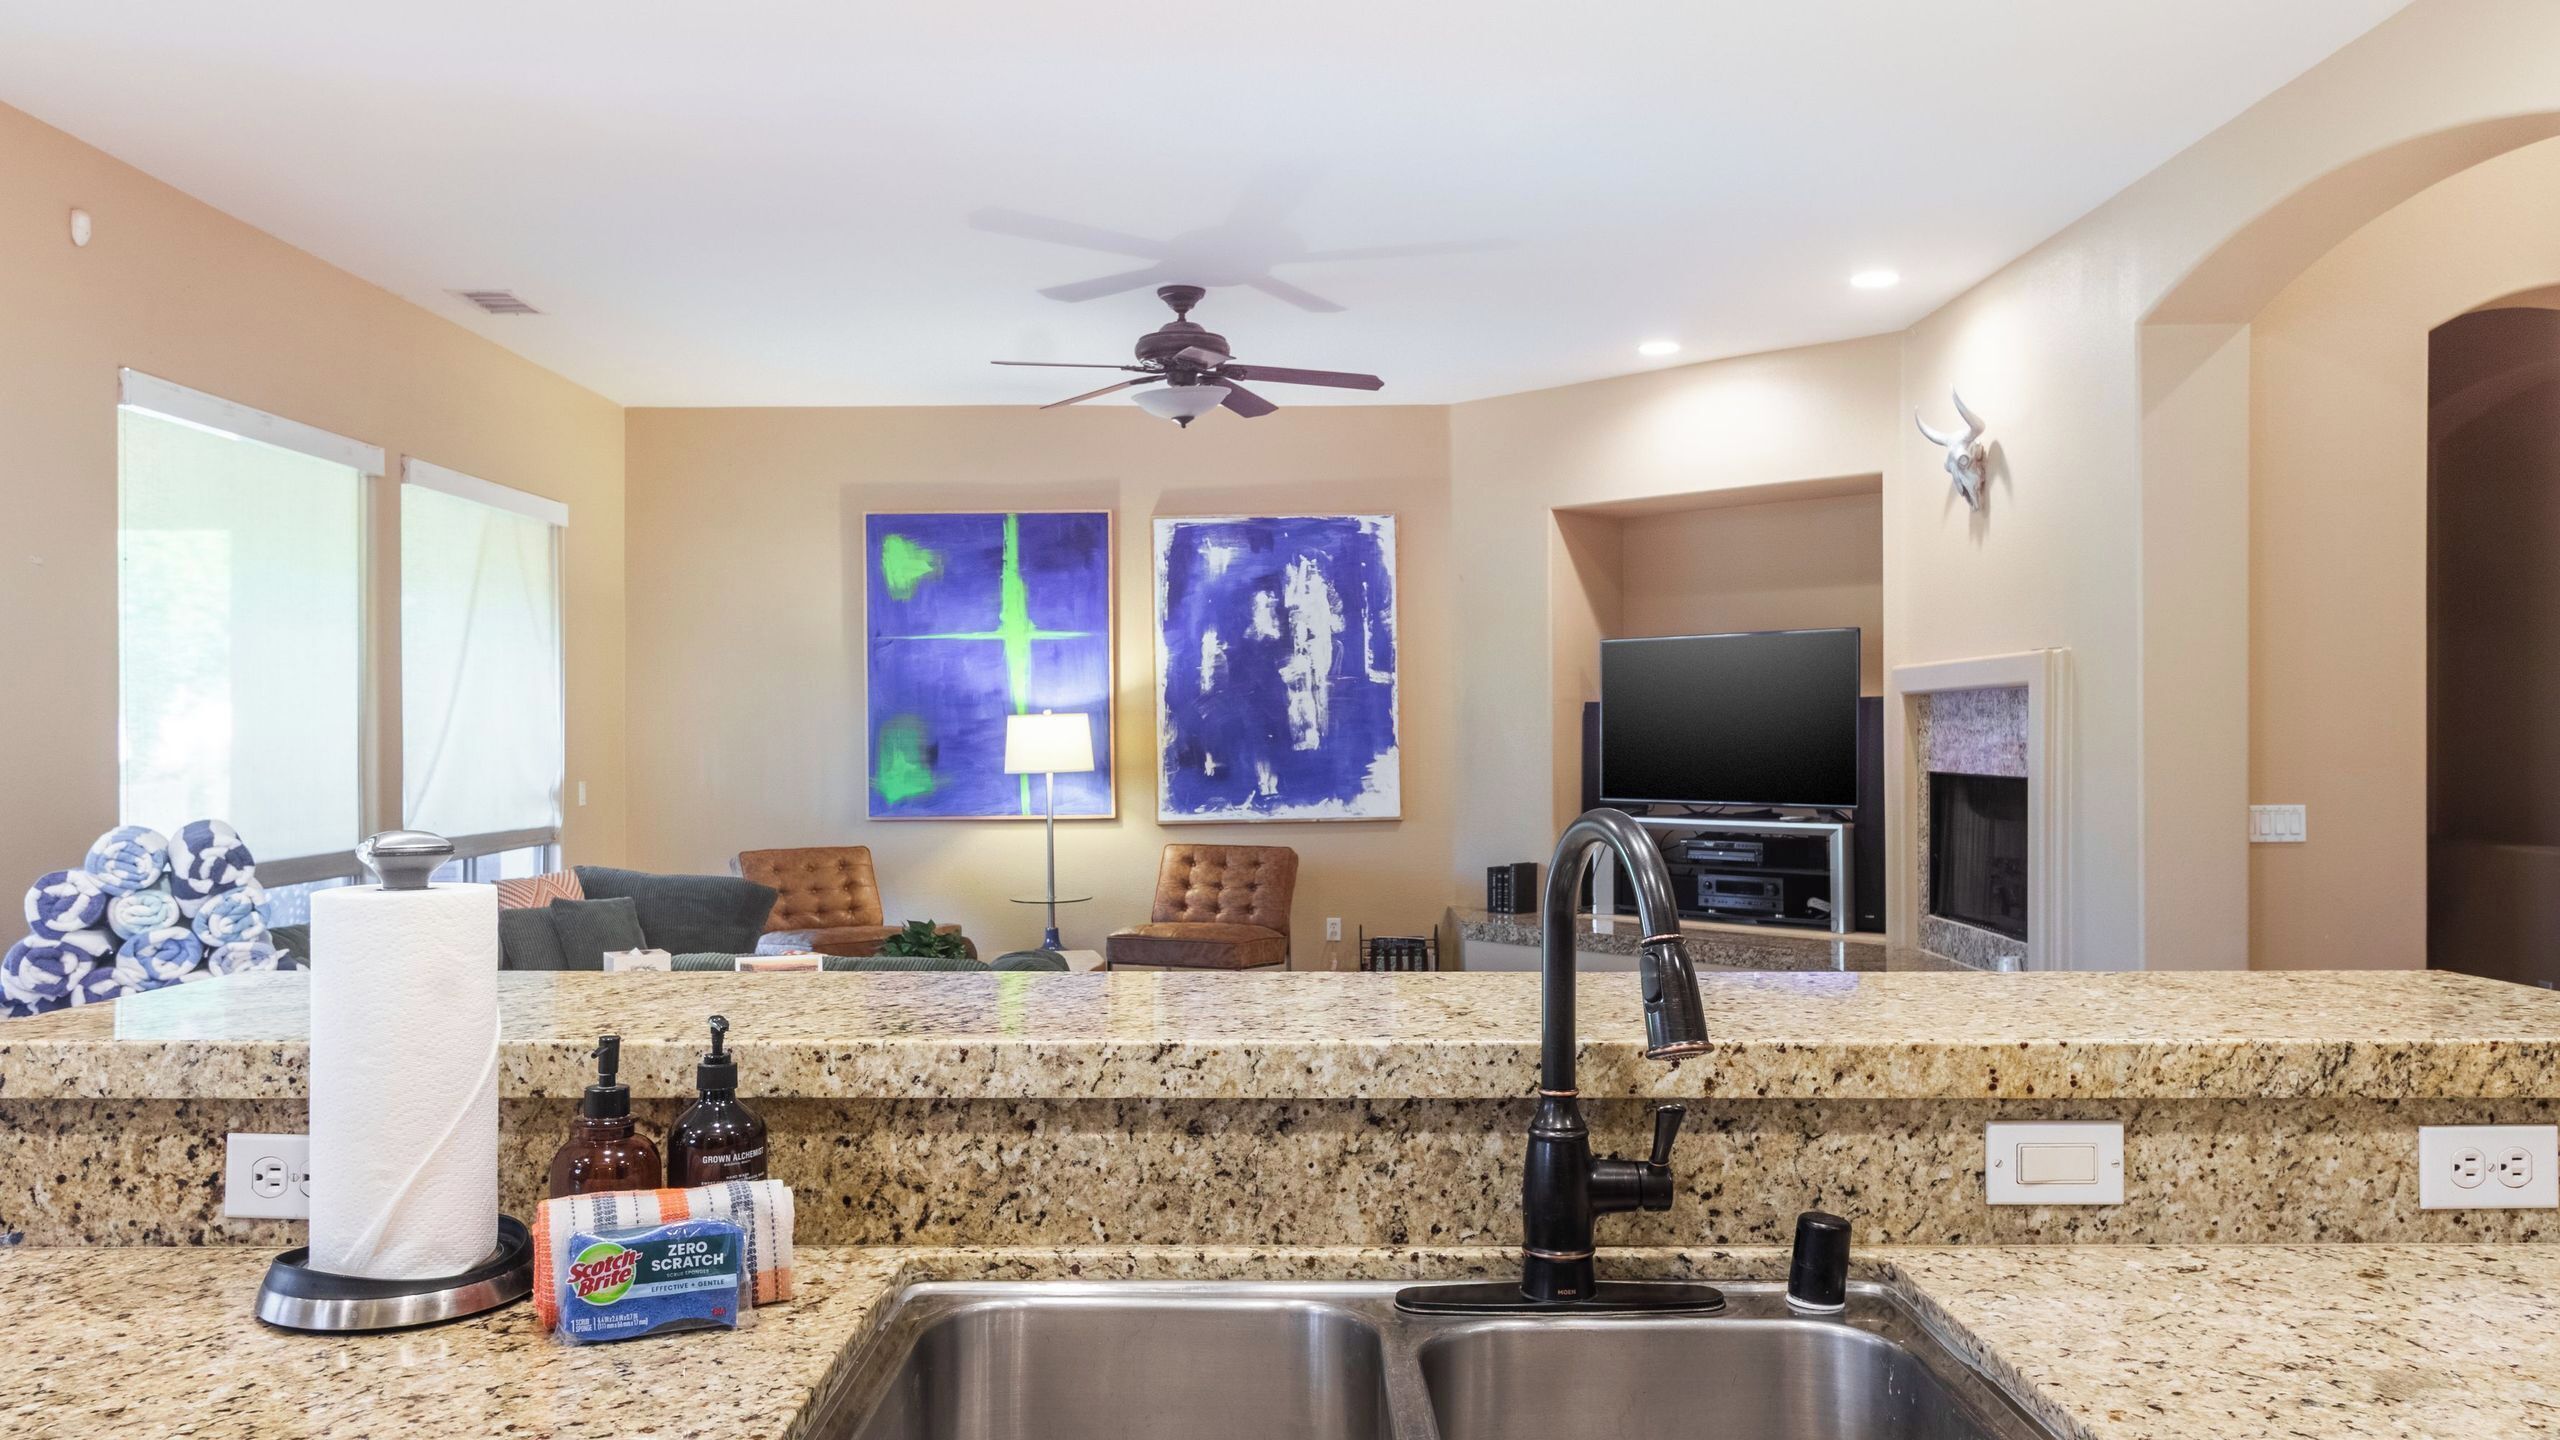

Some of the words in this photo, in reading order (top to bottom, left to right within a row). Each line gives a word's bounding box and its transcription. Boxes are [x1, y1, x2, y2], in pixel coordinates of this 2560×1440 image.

[702, 1155, 731, 1164] GROWN
[733, 1147, 764, 1161] ALCHEMIST
[668, 1241, 708, 1257] ZERO
[651, 1252, 724, 1272] SCRATCH
[577, 1267, 632, 1297] Brite
[651, 1282, 689, 1293] EFFECTIVE
[697, 1279, 725, 1287] GENTLE
